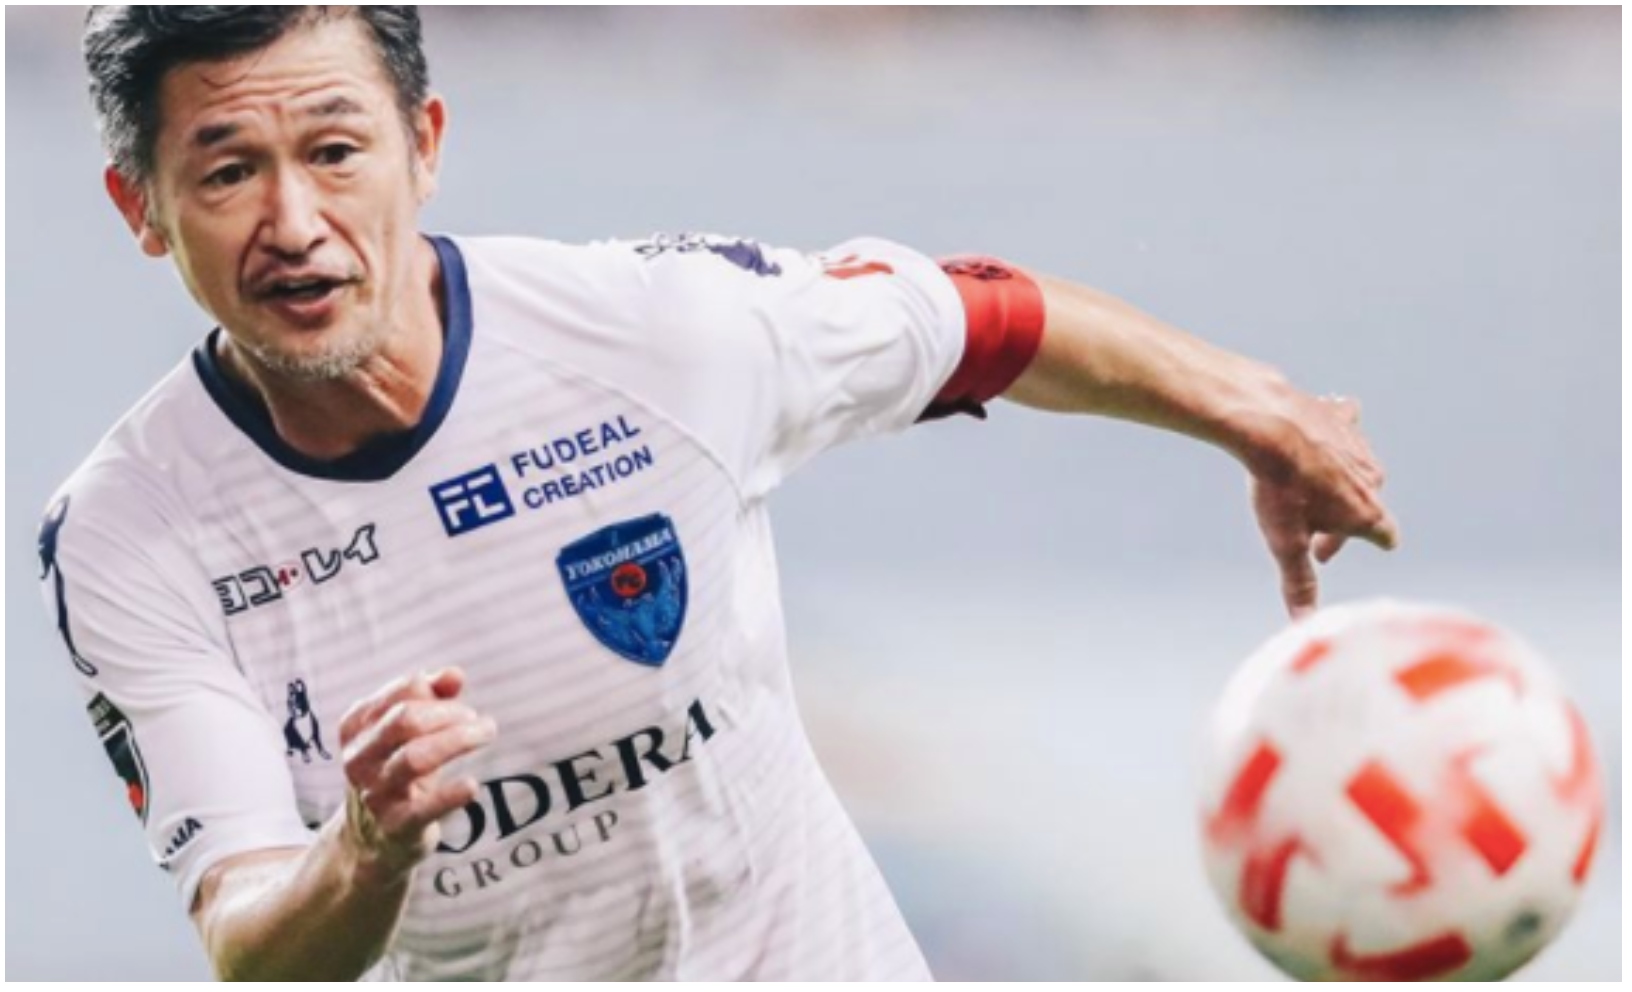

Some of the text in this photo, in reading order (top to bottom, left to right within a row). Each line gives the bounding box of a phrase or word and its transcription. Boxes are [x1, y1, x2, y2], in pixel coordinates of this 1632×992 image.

[510, 414, 641, 478] FUDEAL
[522, 445, 654, 509] CREATION
[567, 527, 673, 581] YOKOHAMA
[433, 809, 620, 898] GROUP
